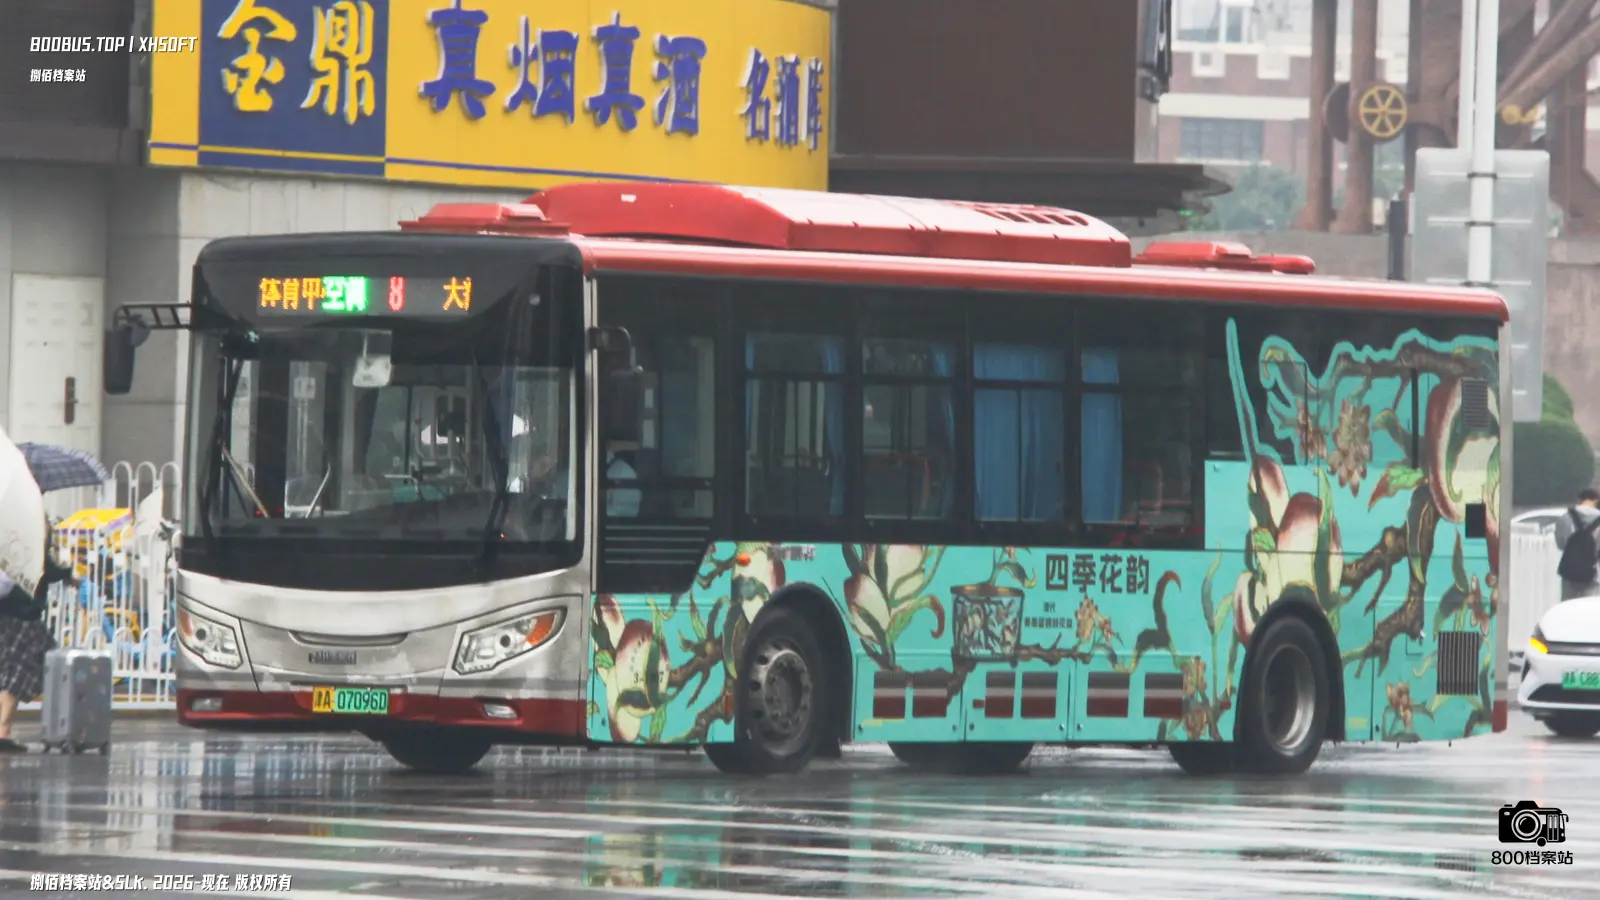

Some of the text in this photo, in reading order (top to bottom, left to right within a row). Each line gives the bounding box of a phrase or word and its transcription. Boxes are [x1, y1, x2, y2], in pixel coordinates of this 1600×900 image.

[217, 0, 376, 125] 金鼎
[418, 0, 707, 136] 真烟真酒
[388, 276, 405, 311] 8
[1045, 553, 1150, 594] 四季花韵
